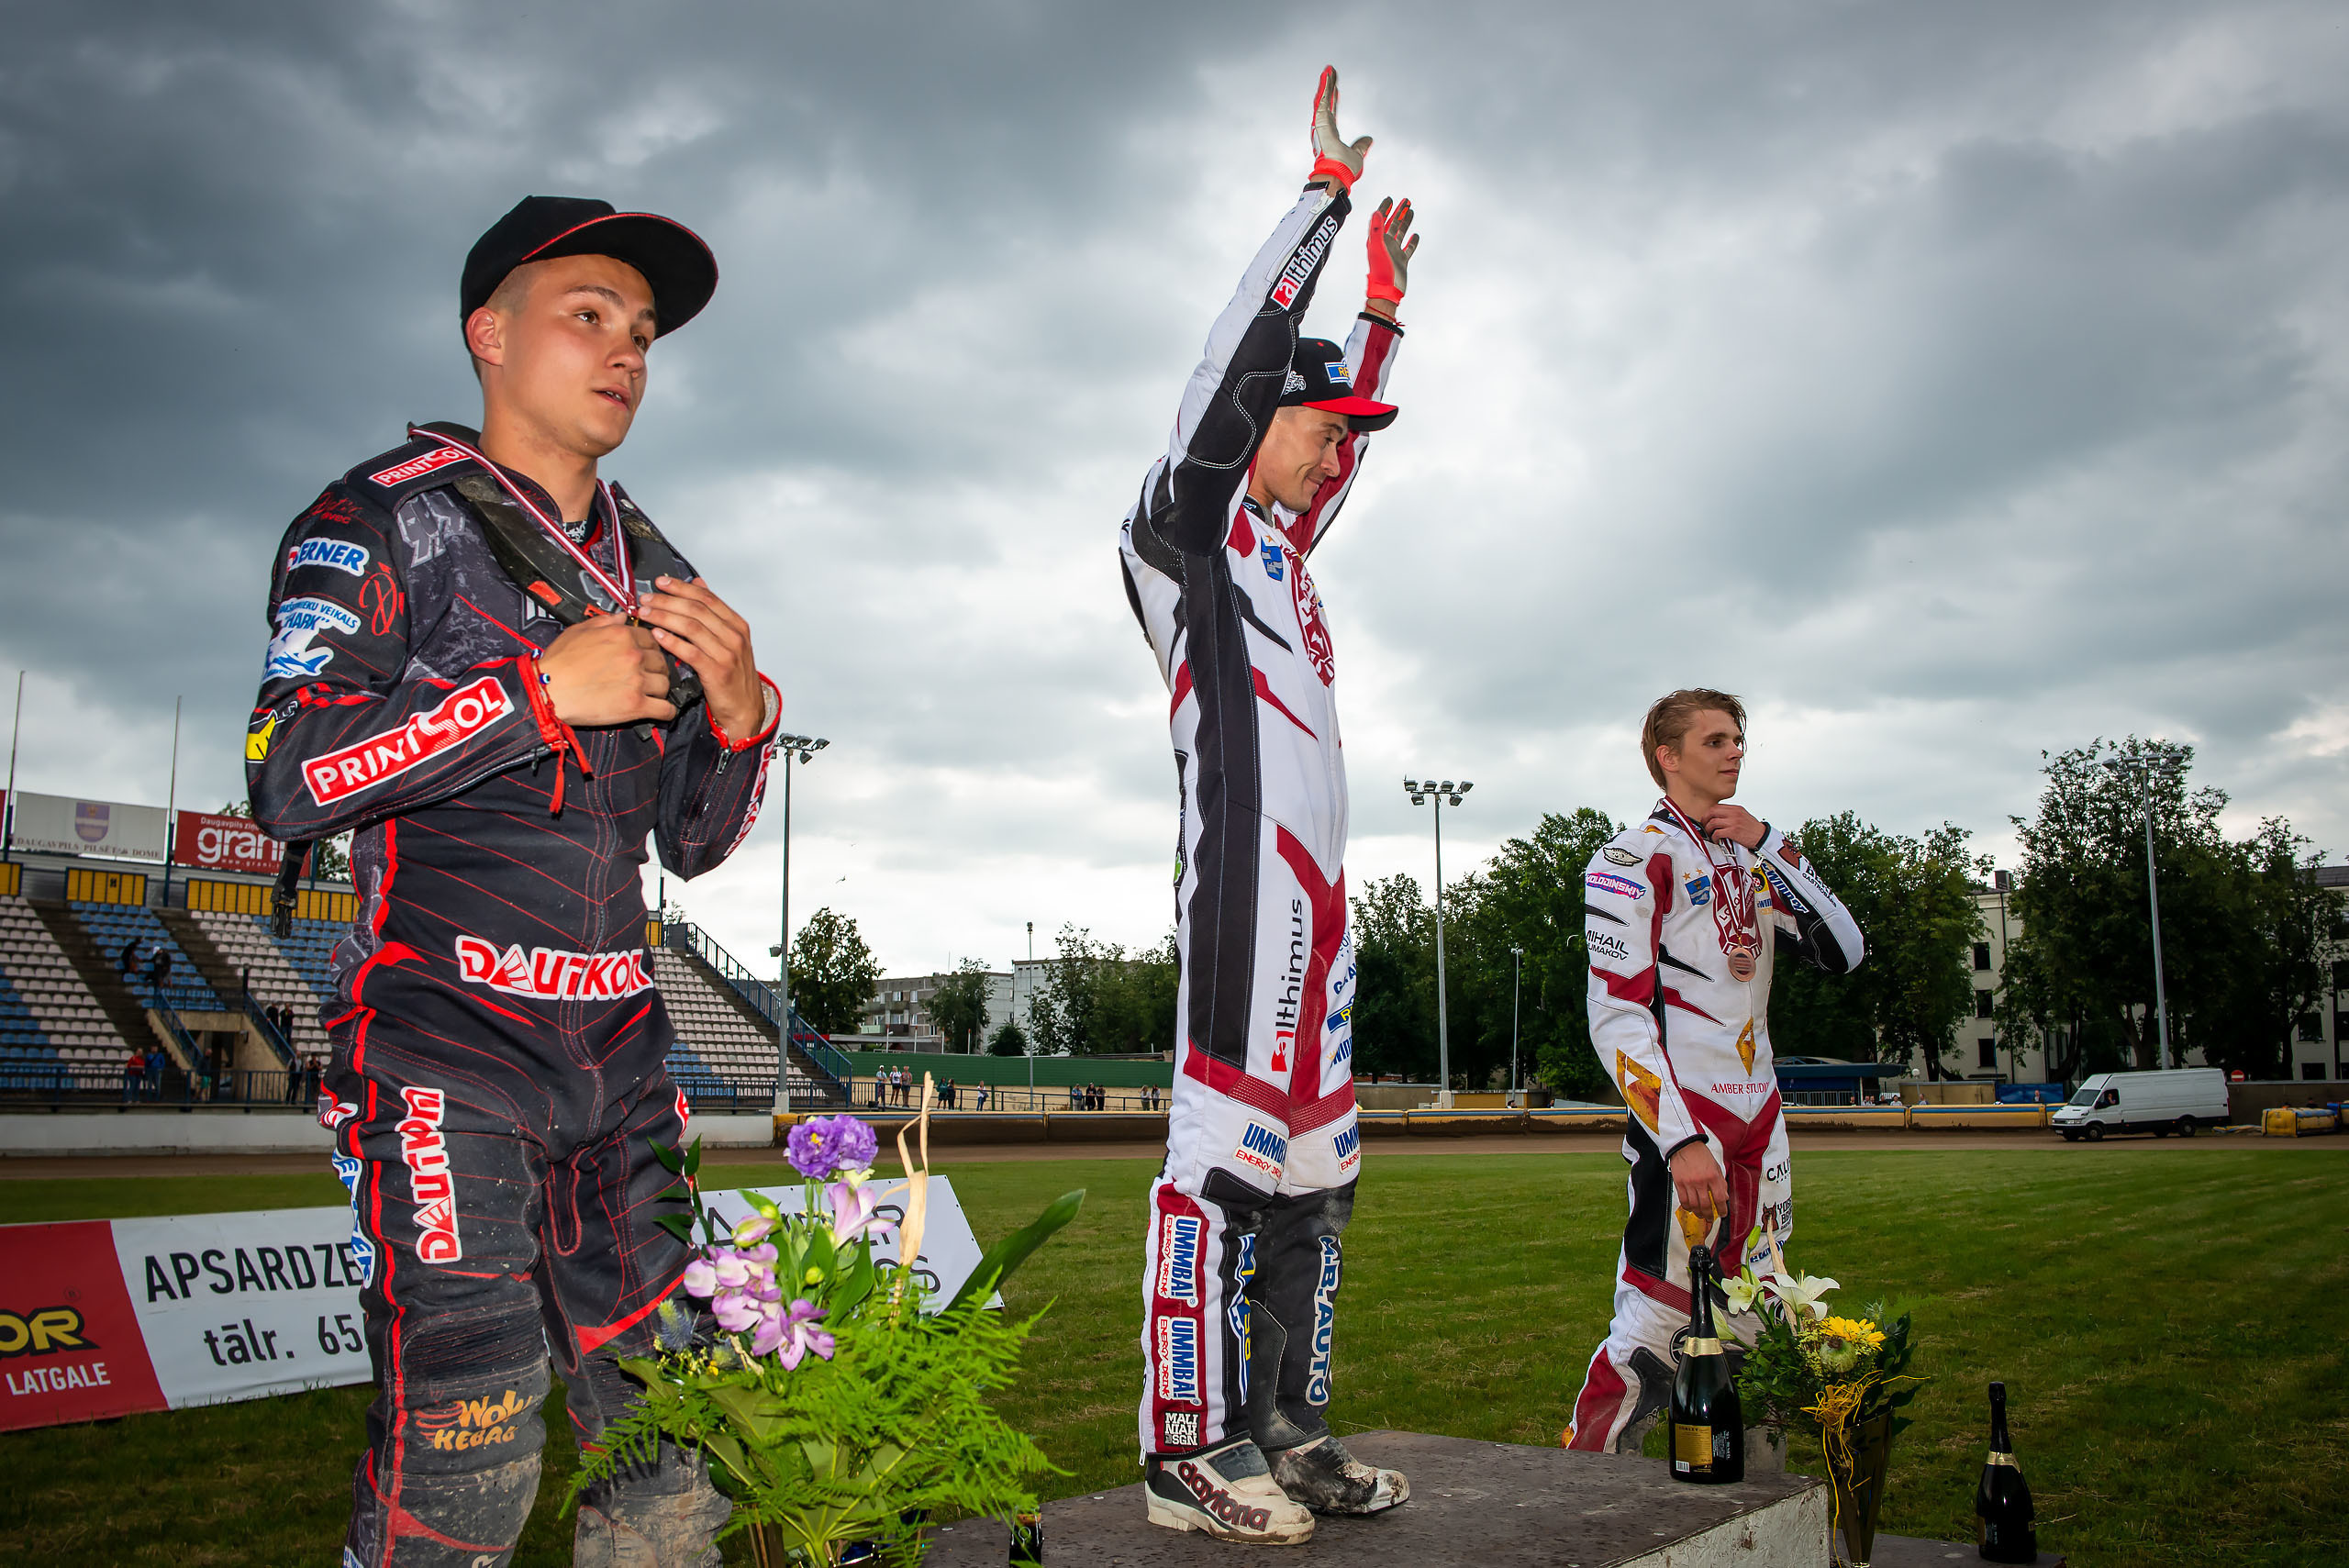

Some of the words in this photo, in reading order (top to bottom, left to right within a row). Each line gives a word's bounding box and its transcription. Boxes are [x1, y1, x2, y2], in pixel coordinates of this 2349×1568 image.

[319, 604, 358, 628] VEIKALS
[313, 687, 502, 794] PRINTSOL
[200, 816, 243, 829] Daugavpils
[17, 836, 79, 851] DAUGAVPILS
[132, 849, 161, 859] DOME
[1710, 1083, 1744, 1095] AMBER
[1235, 1149, 1272, 1172] ENERGY
[1163, 1217, 1173, 1260] ENERGY
[1171, 1218, 1198, 1297] UMMBA!
[1159, 1262, 1170, 1296] DRINK
[204, 1318, 295, 1366] tālr.
[317, 1314, 369, 1355] 65
[1160, 1318, 1169, 1361] ENERGY
[1172, 1319, 1196, 1398] UMMBA!
[6, 1362, 111, 1396] LATGALE
[1160, 1362, 1171, 1397] DRINK
[1165, 1412, 1199, 1425] MALI
[1177, 1461, 1273, 1532] daytona
